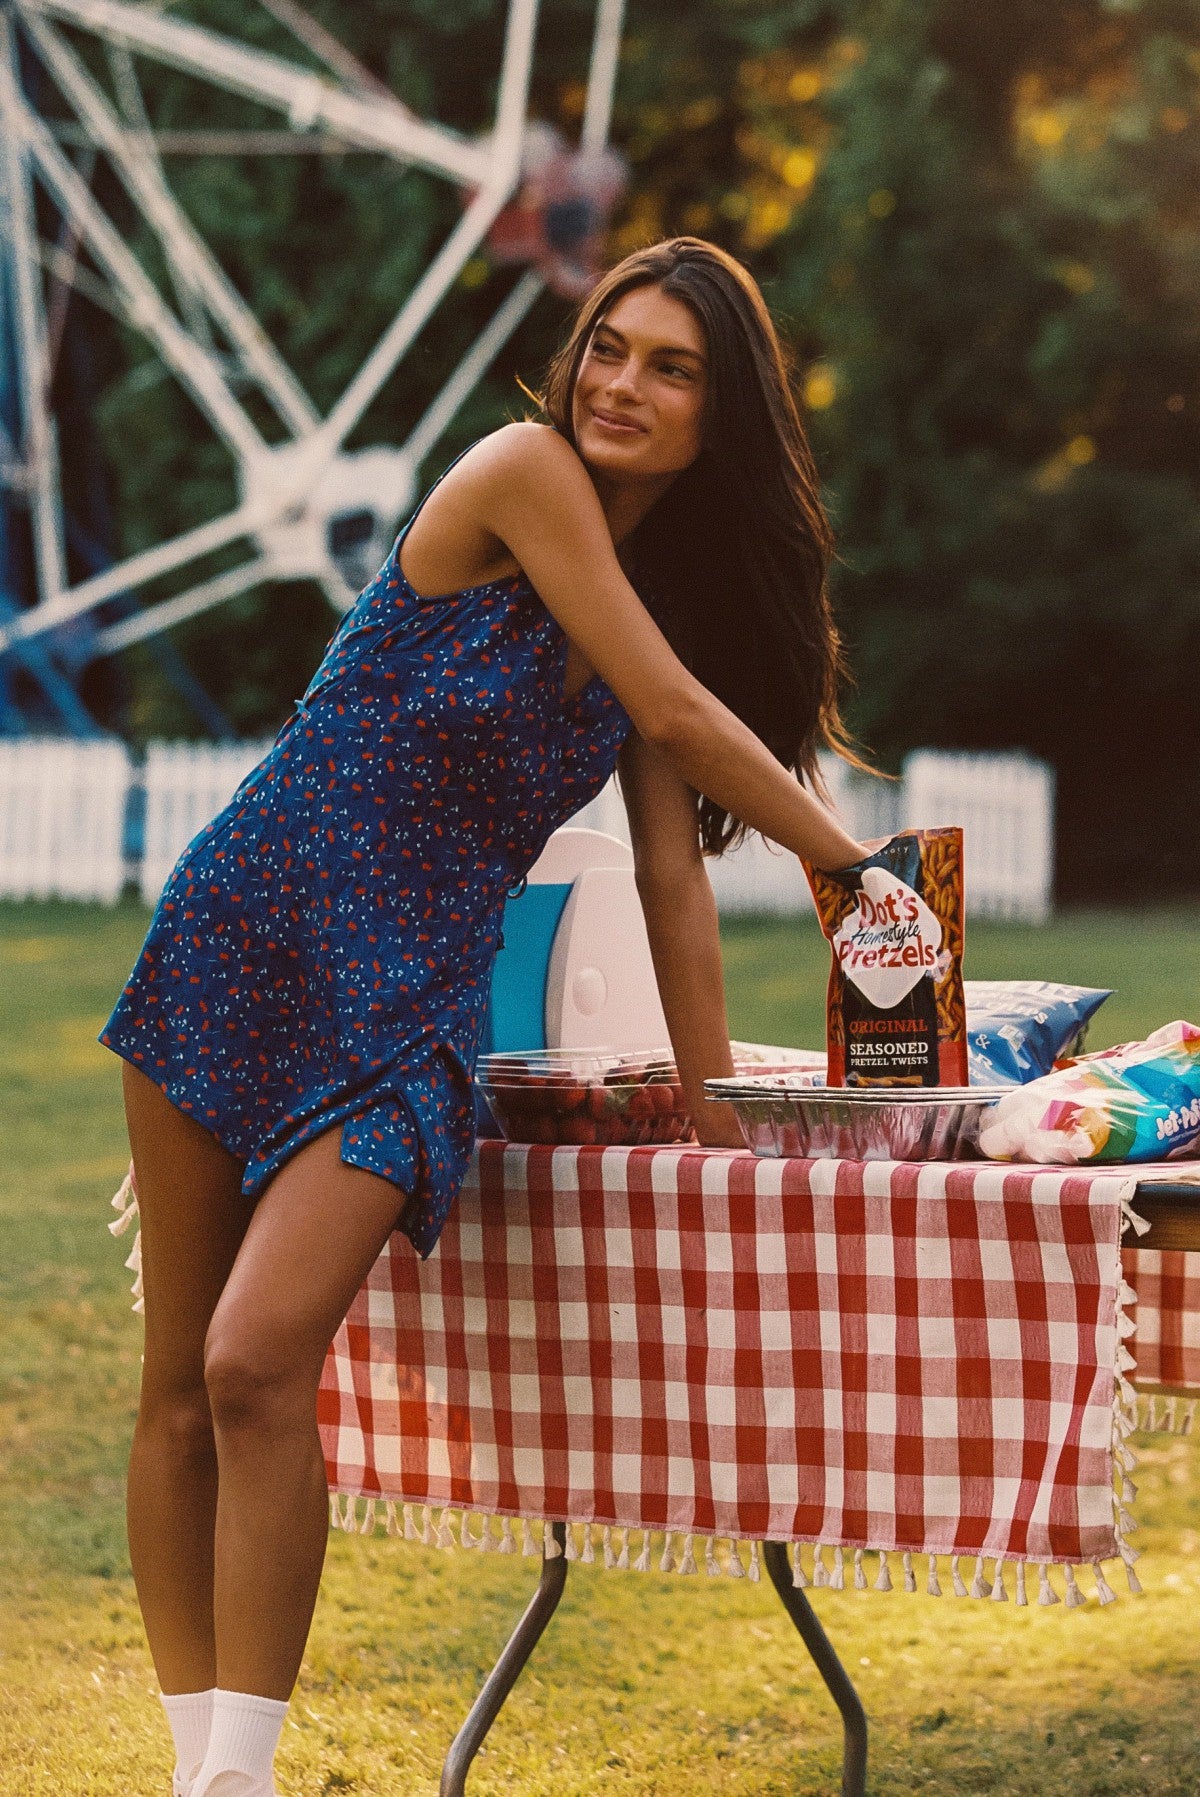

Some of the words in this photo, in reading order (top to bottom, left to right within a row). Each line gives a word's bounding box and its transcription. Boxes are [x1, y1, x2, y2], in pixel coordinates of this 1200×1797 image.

[877, 846, 909, 857] avory
[858, 889, 919, 929] Dot's
[851, 921, 921, 949] Homestyle
[839, 935, 936, 969] Pretzels
[848, 1018, 928, 1034] ORIGINAL
[849, 1042, 929, 1056] SEASONED
[850, 1057, 890, 1067] PRETZEL
[891, 1056, 929, 1066] TWISTS
